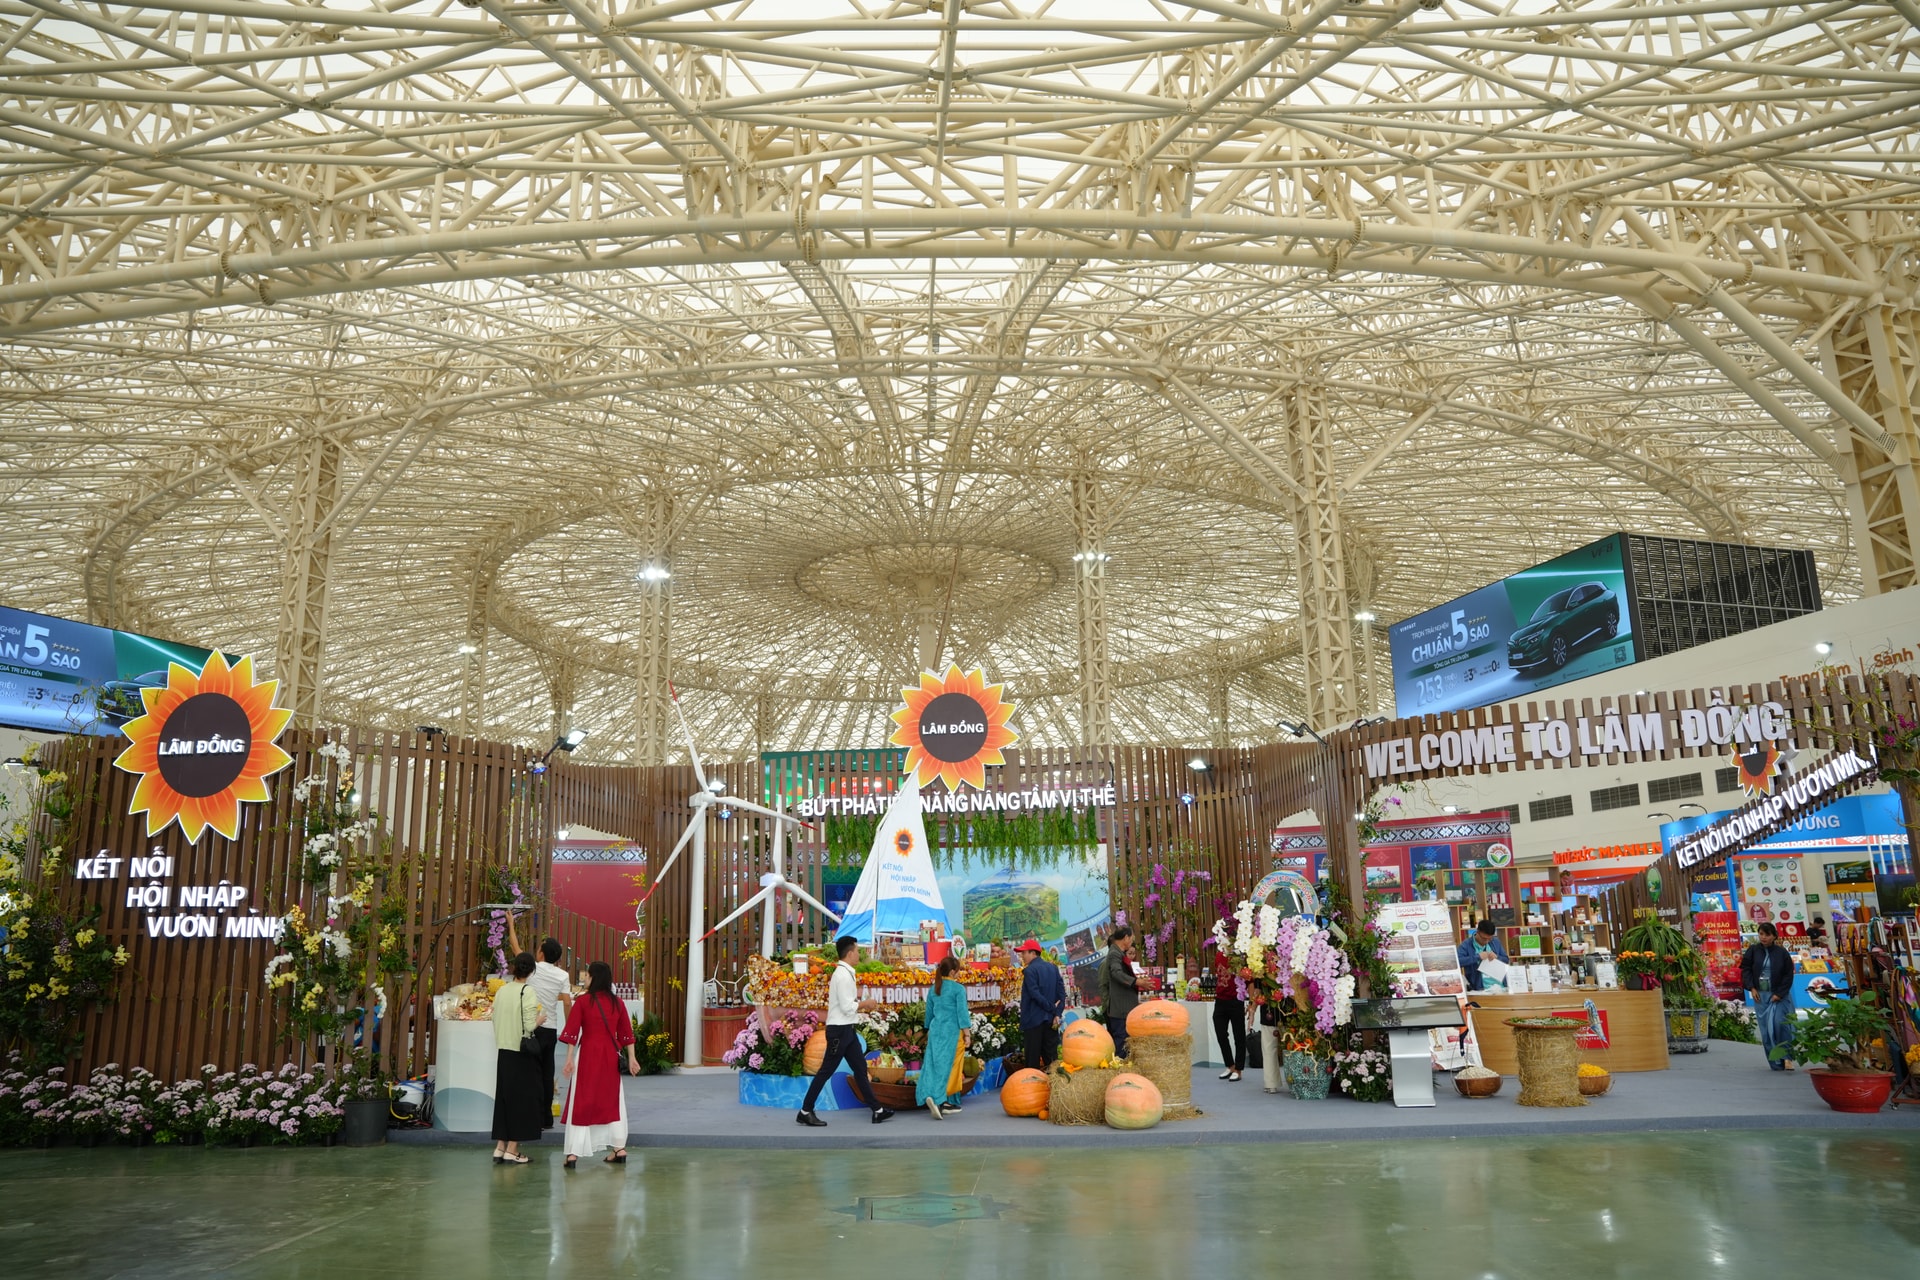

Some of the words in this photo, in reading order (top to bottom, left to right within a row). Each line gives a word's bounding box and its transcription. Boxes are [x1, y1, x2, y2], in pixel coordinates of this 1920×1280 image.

[0, 625, 21, 635] GHIỆM
[1412, 632, 1452, 664] CHUẨN
[1451, 609, 1468, 650] 5
[1470, 624, 1490, 642] SAO
[21, 624, 50, 666] 5
[50, 651, 81, 670] SAO
[1873, 648, 1914, 668] Sảnh
[0, 681, 17, 690] RIỆU
[1415, 674, 1443, 707] 253
[922, 722, 947, 735] LÂM
[949, 719, 985, 734] ĐỒNG
[1364, 724, 1517, 779] WELCOME
[1523, 720, 1571, 760] TO
[1578, 707, 1665, 755] LÂM
[1681, 690, 1788, 748] ĐỒNG
[159, 739, 195, 756] LÂM
[196, 734, 246, 755] ĐỒNG
[801, 791, 841, 817] BỨT
[842, 793, 878, 816] PHÁ
[920, 790, 969, 814] NĂNG
[971, 790, 1020, 811] NÂNG
[1021, 783, 1056, 810] TẦM
[1079, 779, 1116, 807] THẾ
[76, 849, 124, 879] KẾT
[130, 846, 174, 878] NỐI
[1598, 842, 1648, 862] MẠNH
[126, 881, 171, 912] HỘI
[180, 880, 248, 913] NHẬP
[147, 913, 217, 938] VƯƠN
[886, 984, 919, 1003] ĐỒNG
